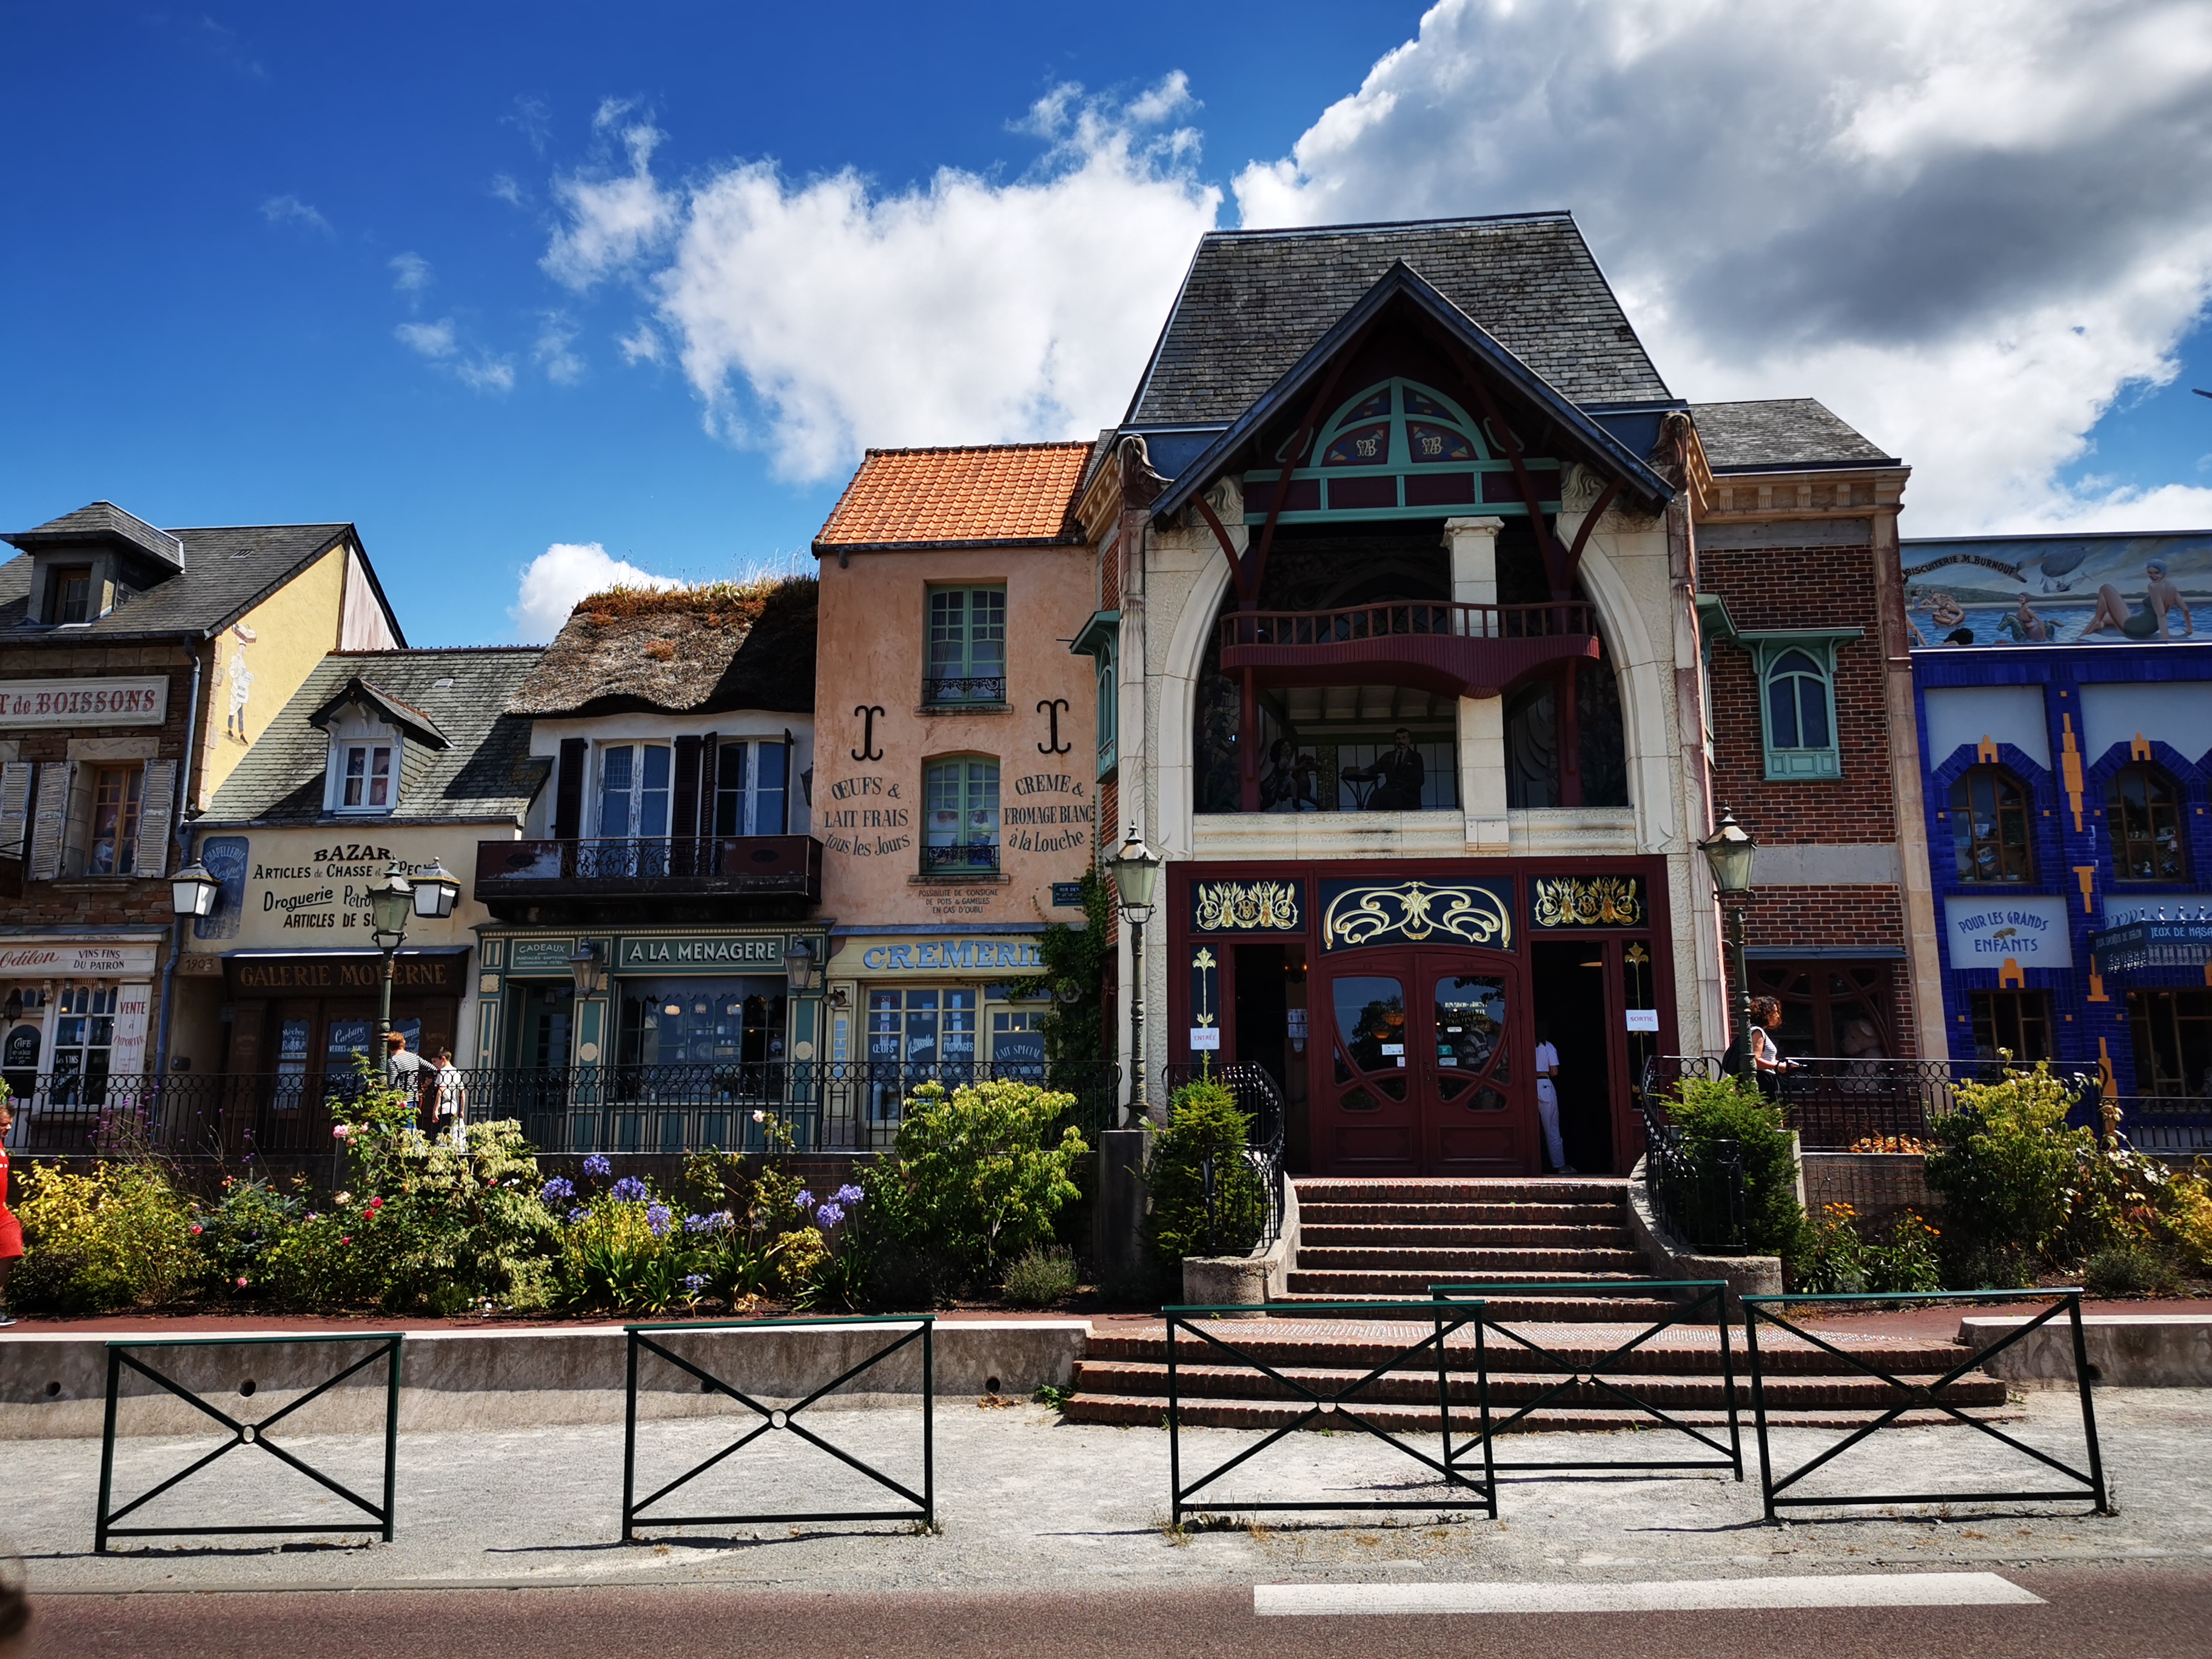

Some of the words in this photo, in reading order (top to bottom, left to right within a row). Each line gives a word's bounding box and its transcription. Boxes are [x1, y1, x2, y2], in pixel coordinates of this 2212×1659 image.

[1905, 555, 1959, 577] BISCUITERIE
[13, 695, 30, 714] de
[35, 689, 156, 714] BOISSONS
[831, 777, 883, 800] ŒUFS
[888, 783, 901, 799] &
[1015, 774, 1071, 796] CREME
[1072, 782, 1084, 797] &
[824, 810, 858, 828] LAIT
[863, 808, 909, 827] FRAIS
[1004, 806, 1056, 825] FROMAGE
[1058, 805, 1092, 823] BLANC
[825, 831, 851, 854] tous
[853, 835, 871, 856] les
[875, 834, 911, 856] Jours
[1008, 828, 1018, 848] à
[1019, 830, 1032, 851] la
[1035, 829, 1085, 852] Louche
[204, 845, 246, 864] CHAPELLERIE
[313, 844, 391, 862] BAZAR
[253, 864, 311, 880] ARTICLES
[314, 868, 323, 879] de
[327, 863, 373, 878] CHASSE
[264, 885, 333, 912] Droguerie
[283, 913, 335, 929] ARTICLES
[343, 913, 357, 928] DE
[1958, 914, 1987, 934] POUR
[1987, 911, 2004, 925] LES
[2007, 910, 2049, 931] GRANDS
[2151, 927, 2171, 939] JEUX
[2173, 927, 2185, 937] DE
[78, 949, 99, 959] VINS
[101, 950, 121, 959] FINS
[519, 943, 565, 953] CADEAUX
[628, 942, 643, 961] A
[649, 942, 669, 961] LA
[677, 942, 776, 961] MENAGERE
[1974, 938, 2038, 953] ENFANTS
[0, 950, 59, 968] Odilon
[73, 960, 85, 969] DU
[90, 960, 124, 970] PATRON
[240, 965, 331, 987] GALERIE
[120, 1002, 146, 1014] VENTE
[943, 1042, 973, 1052] FROMAGES
[995, 1046, 1011, 1060] LAIT
[1013, 1044, 1041, 1060] SPECIAL
